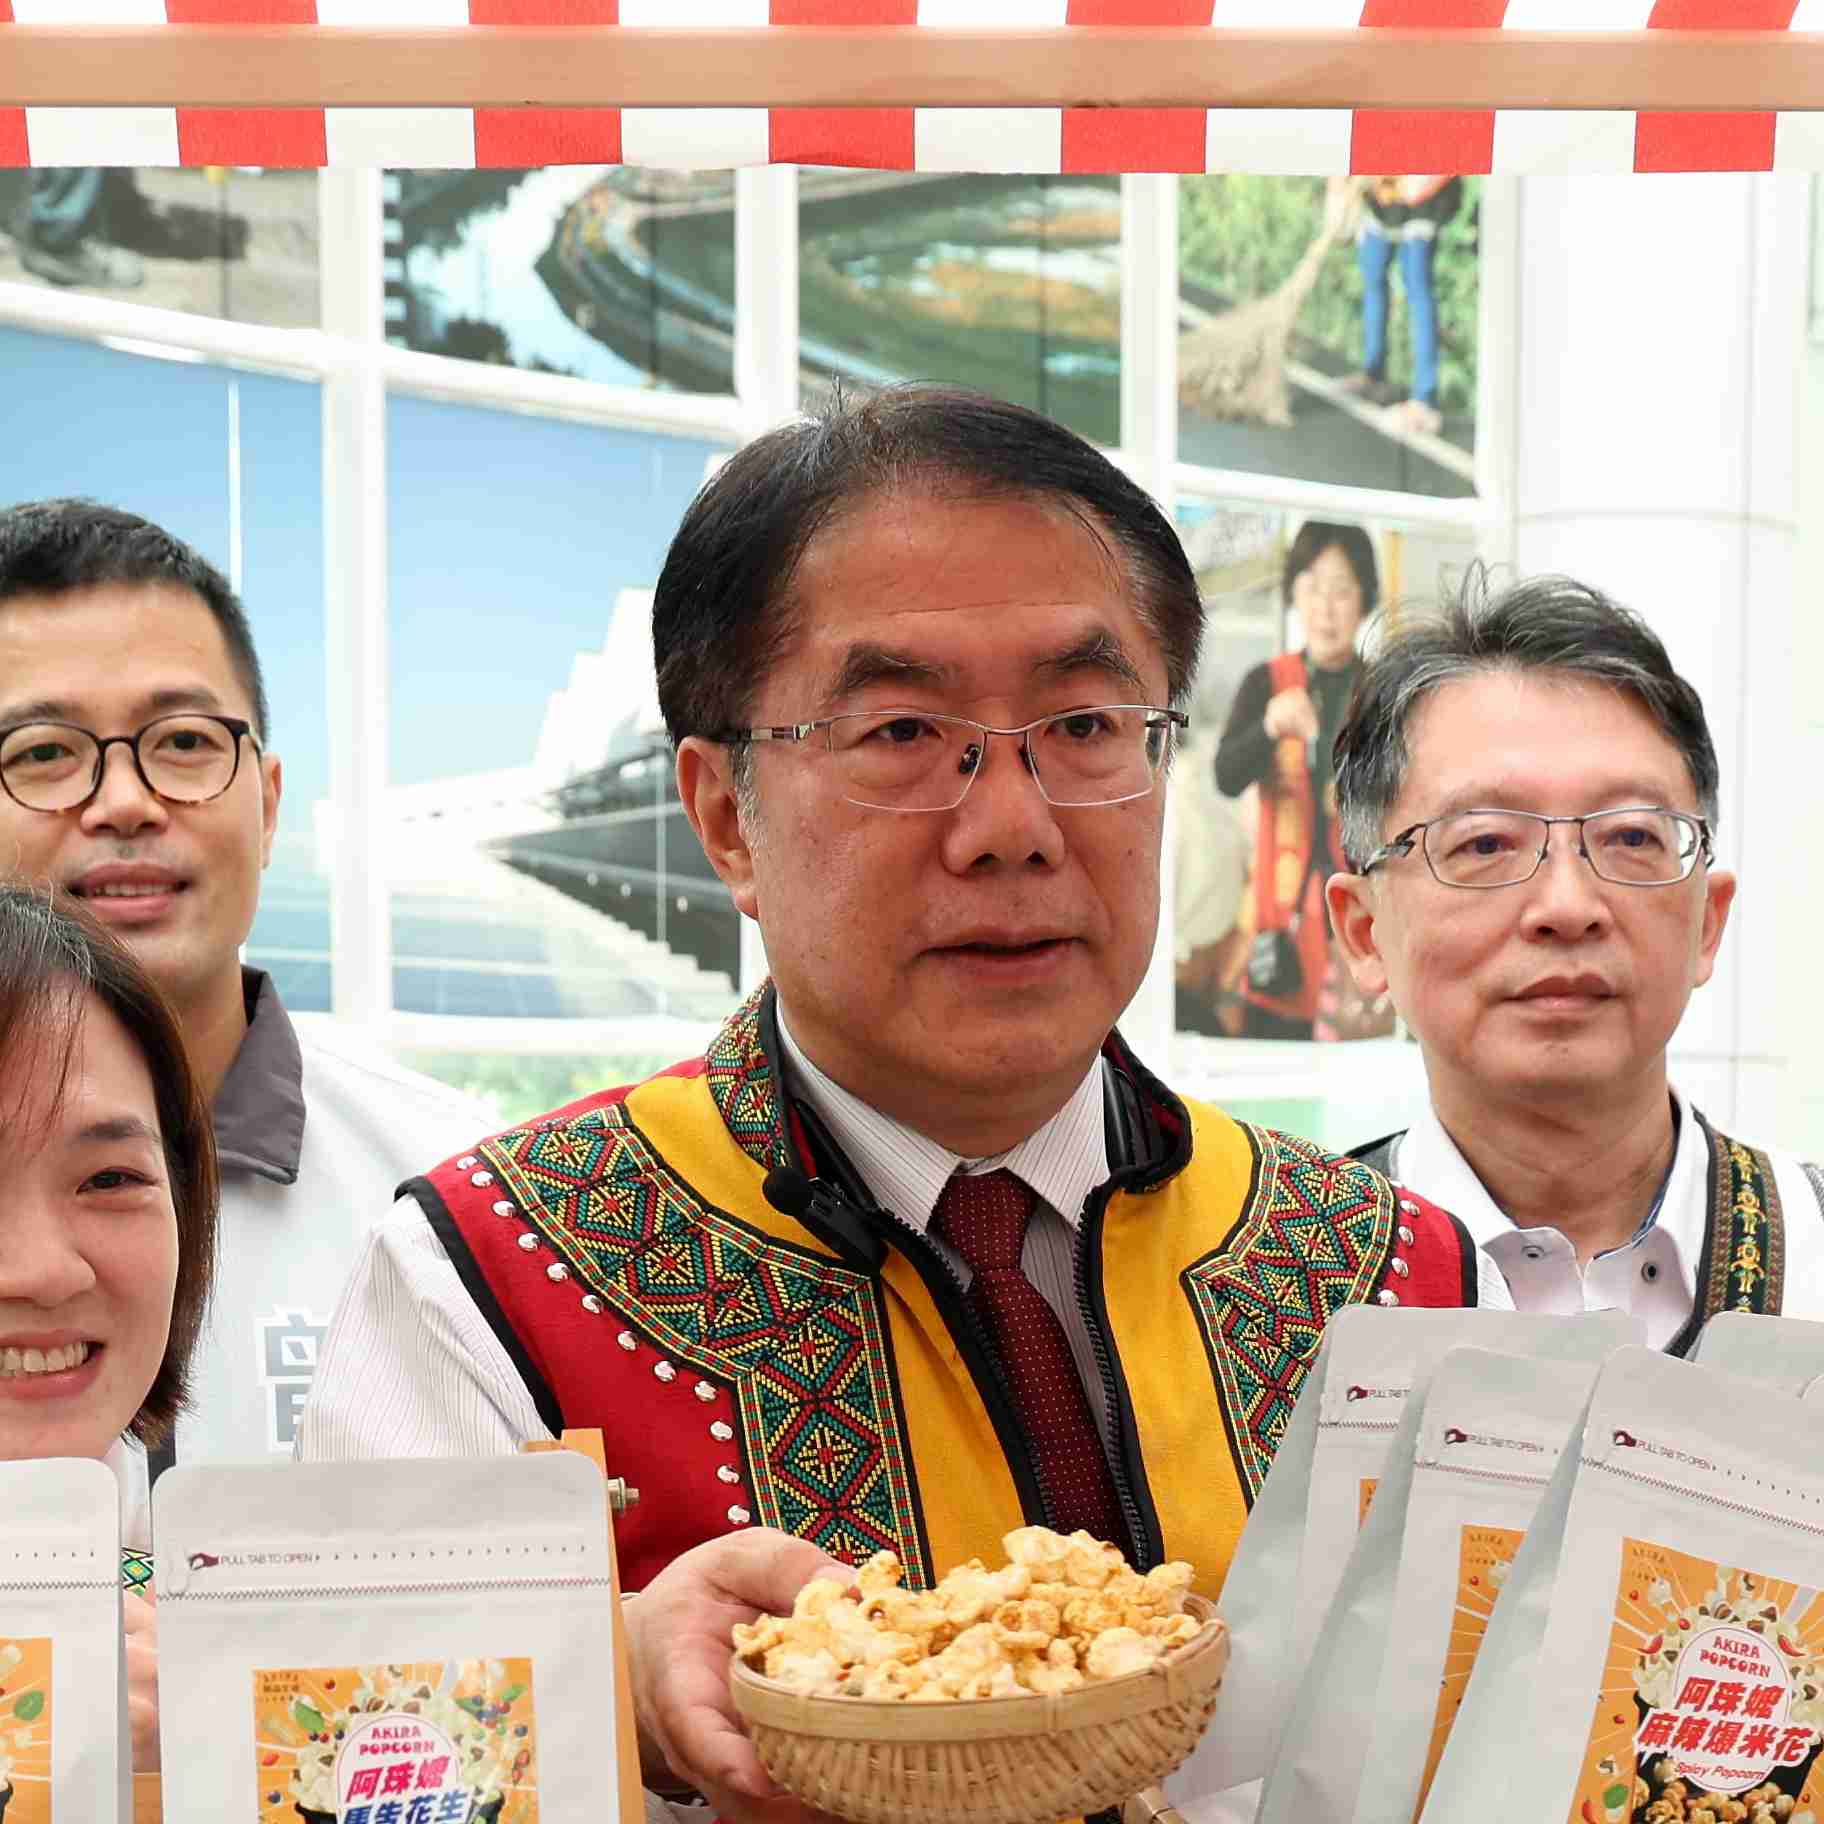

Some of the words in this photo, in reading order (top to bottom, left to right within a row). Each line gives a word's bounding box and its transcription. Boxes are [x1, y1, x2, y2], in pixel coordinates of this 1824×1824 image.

[1713, 1636, 1760, 1658] AKIRA
[1699, 1649, 1771, 1678] POPCORN
[371, 1727, 422, 1739] AKIRA
[1638, 1712, 1815, 1763] 麻辣爆米花
[359, 1741, 434, 1755] POPCORN
[1675, 1762, 1710, 1779] Spicy
[1711, 1764, 1766, 1780] Popcorn
